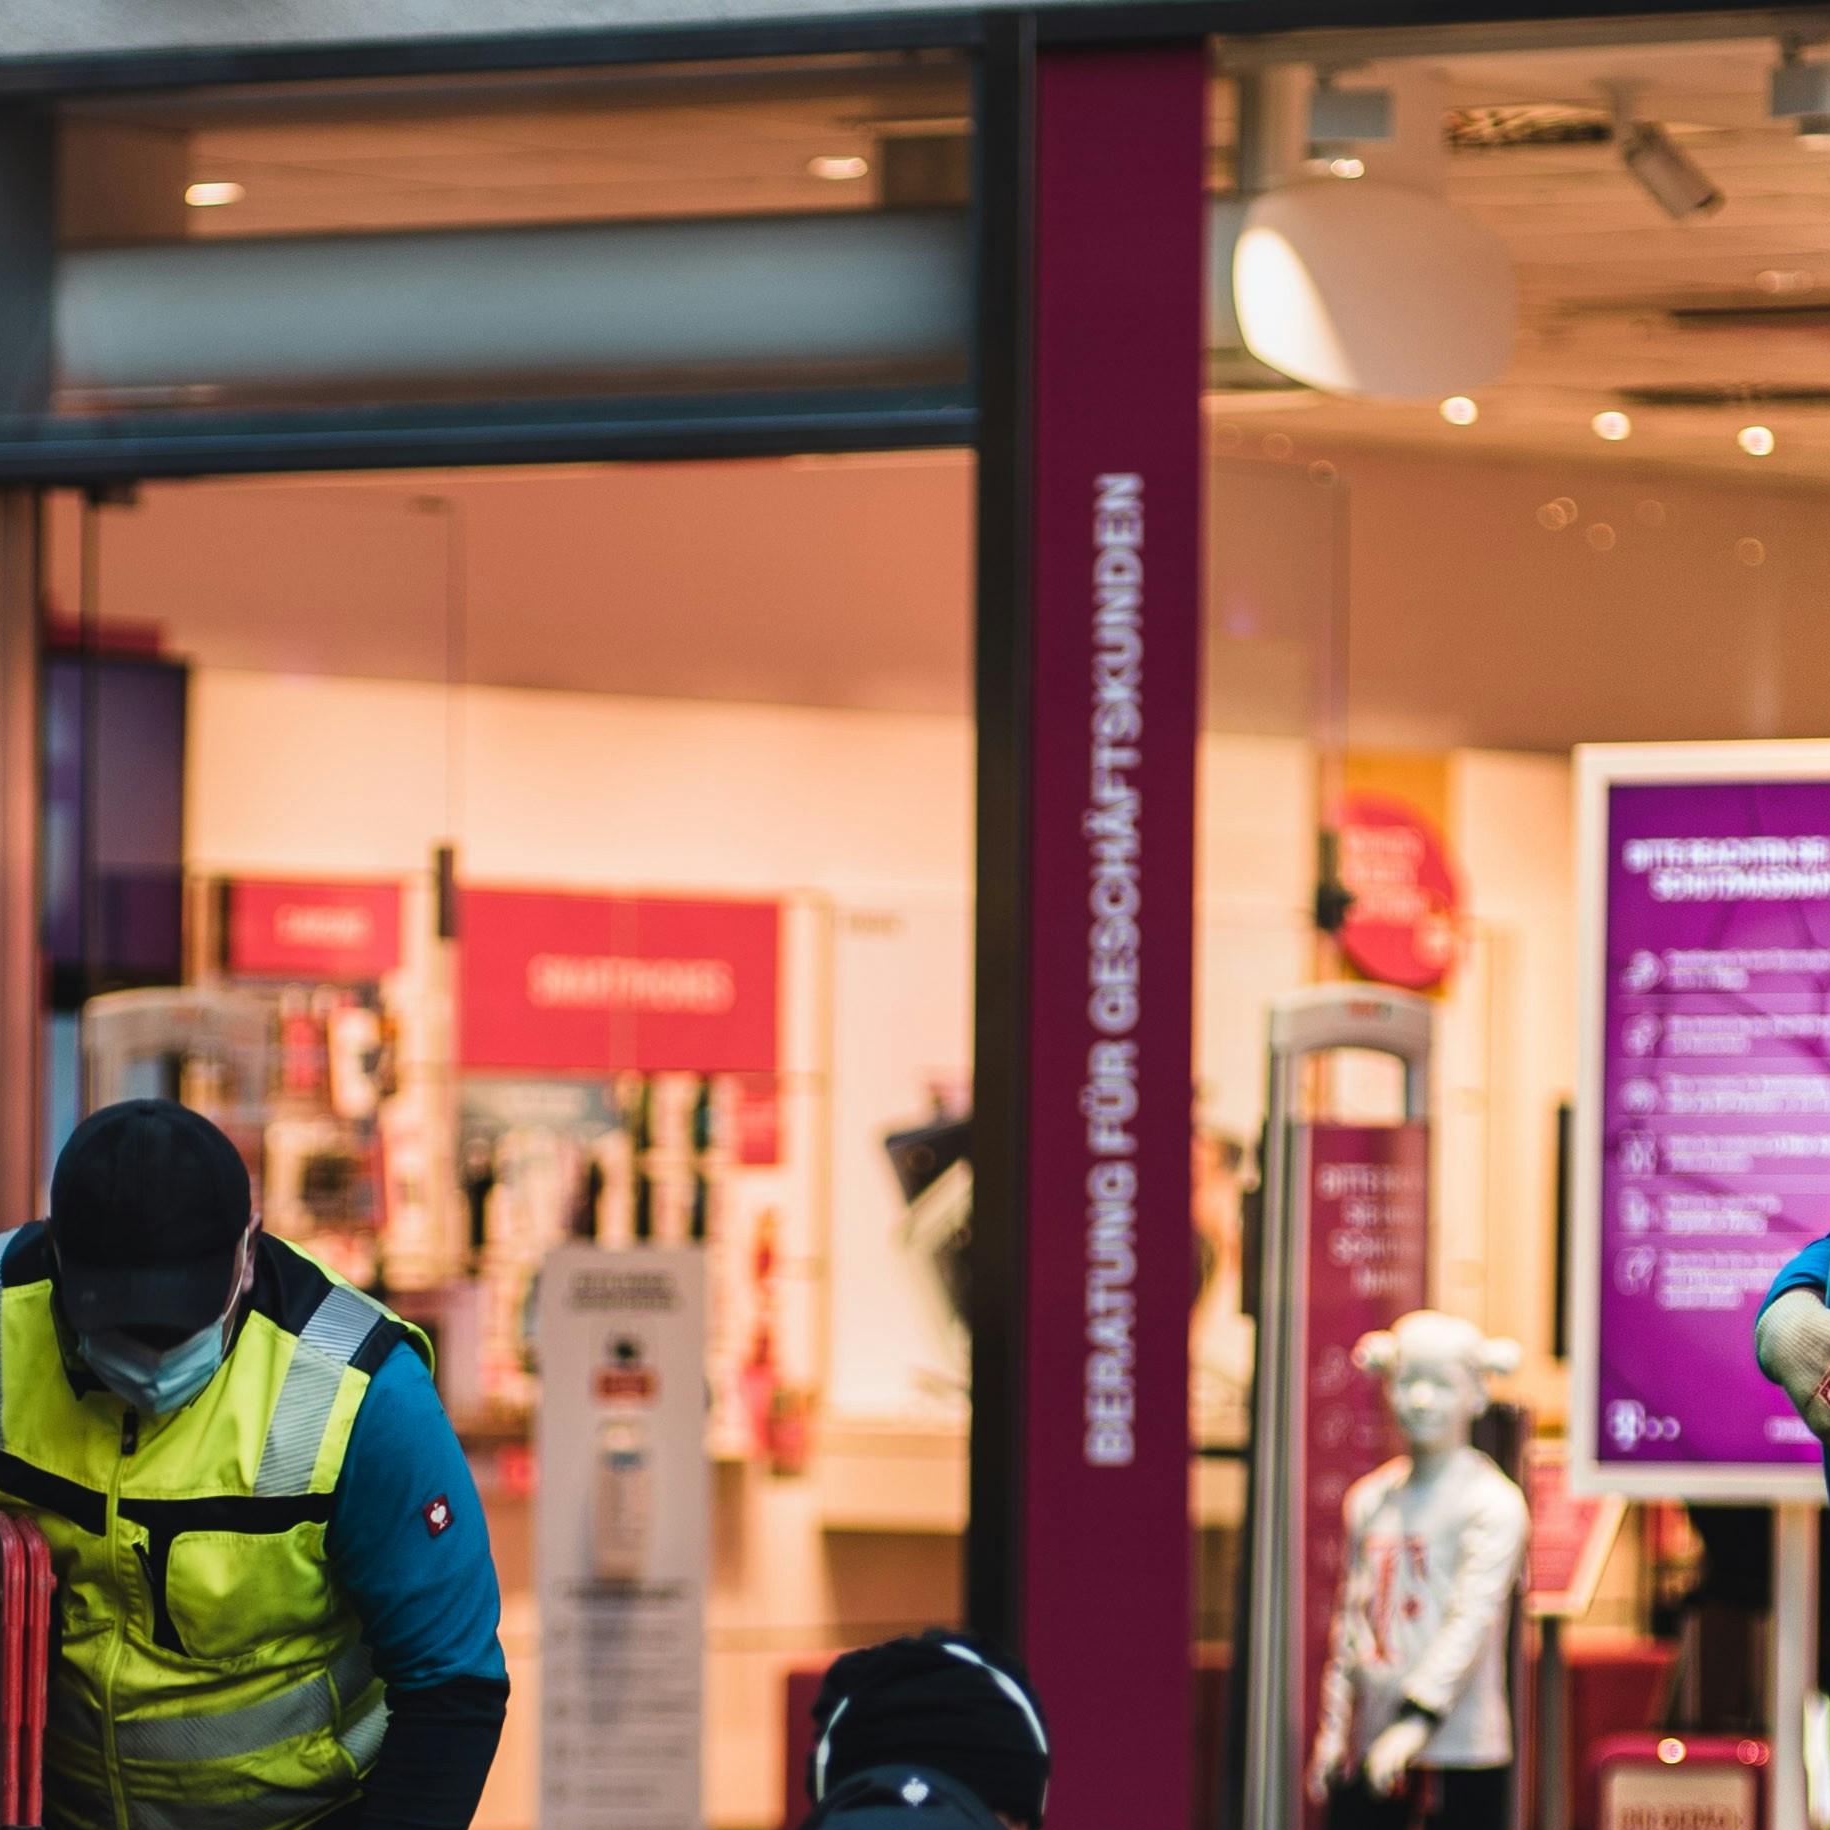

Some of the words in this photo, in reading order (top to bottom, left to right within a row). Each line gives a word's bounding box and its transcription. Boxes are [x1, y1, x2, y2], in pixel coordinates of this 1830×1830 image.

[1082, 471, 1146, 1034] GESCHÄFTSKUNDEN
[1079, 1038, 1138, 1154] FÜR
[1083, 1160, 1138, 1466] BERATUNG
